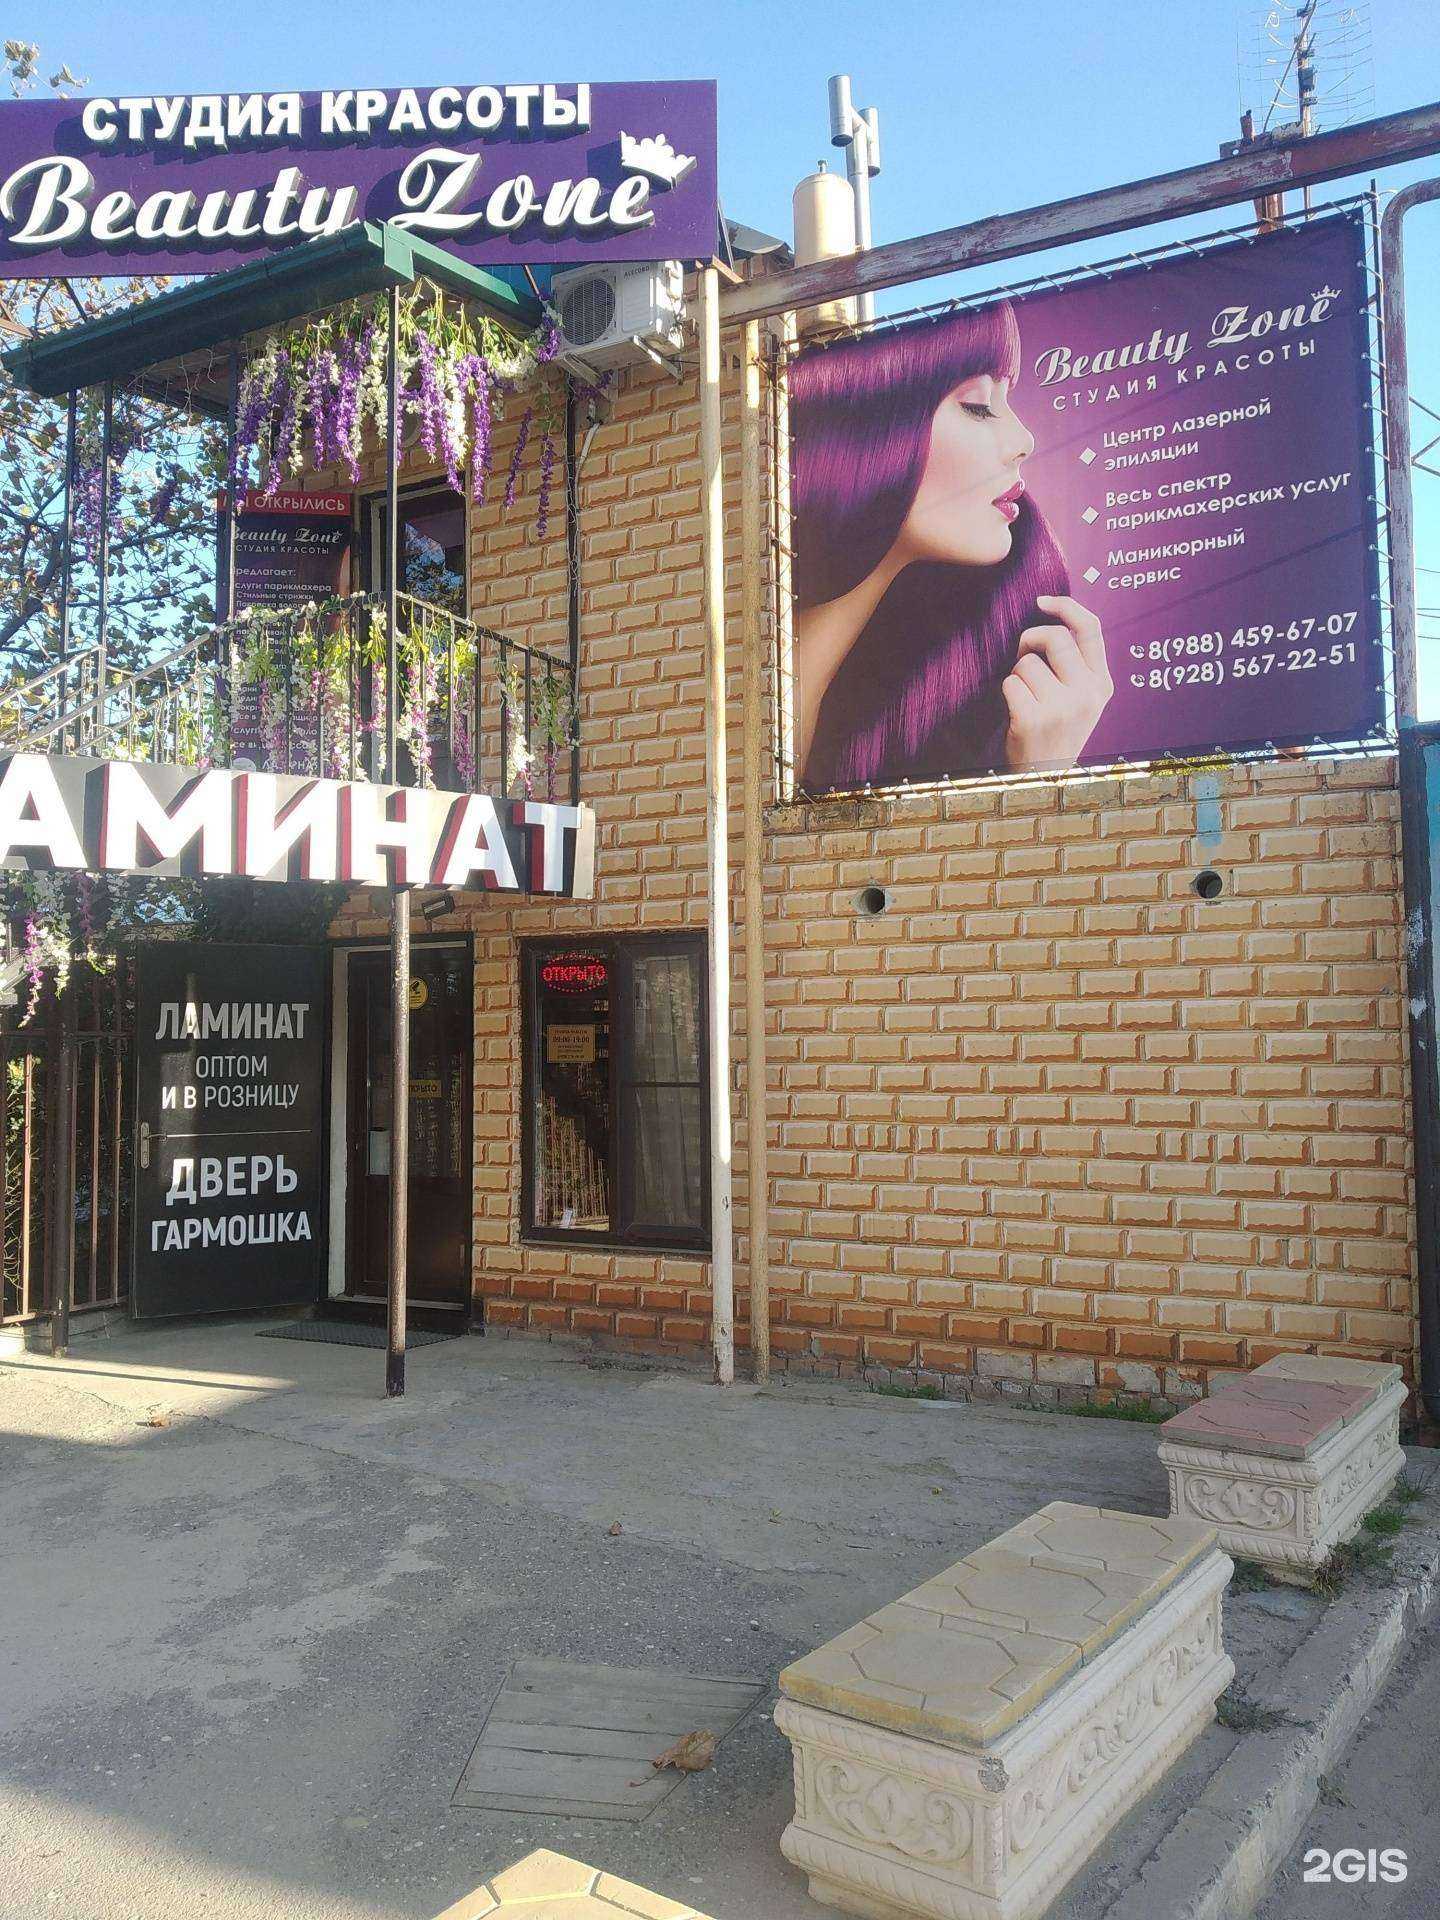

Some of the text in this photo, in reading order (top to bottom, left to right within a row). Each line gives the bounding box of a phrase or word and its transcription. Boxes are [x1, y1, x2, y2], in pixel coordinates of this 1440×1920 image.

[82, 84, 591, 149] СТУДИЯ КРАСОТЫ
[0, 147, 655, 243] Beauty Zone
[1034, 296, 1334, 387] Beauty Zone
[1052, 338, 1316, 411] СТУДИЯ КРАСОТЫ
[1102, 397, 1272, 449] Центр лазерной
[1103, 439, 1199, 472] эпиляции
[254, 496, 346, 511] ОТКРЫЛИСЬ
[1105, 471, 1232, 509] Весь спектр
[1105, 471, 1352, 531] парикмахерских услуг
[235, 544, 329, 555] СТУДИЯ КРАСОТЫ
[295, 527, 342, 544] Zone
[1106, 527, 1246, 567] Маникюрный
[234, 583, 332, 593] слуги парикмахера
[235, 568, 297, 578] редлагает:
[1107, 566, 1182, 592] сервис
[1148, 611, 1358, 663] 8(988) 459-67-07
[1148, 642, 1356, 691] 8(928) 567-22-51
[543, 965, 606, 981] ОТКРЫТО
[155, 1001, 310, 1040] ЛАМИНАТ
[195, 1055, 268, 1079] ОПТОМ
[161, 1083, 300, 1110] И В РОЗНИЦУ
[165, 1154, 298, 1207] ДВЕРЬ
[151, 1210, 312, 1252] ГАРМОШКА
